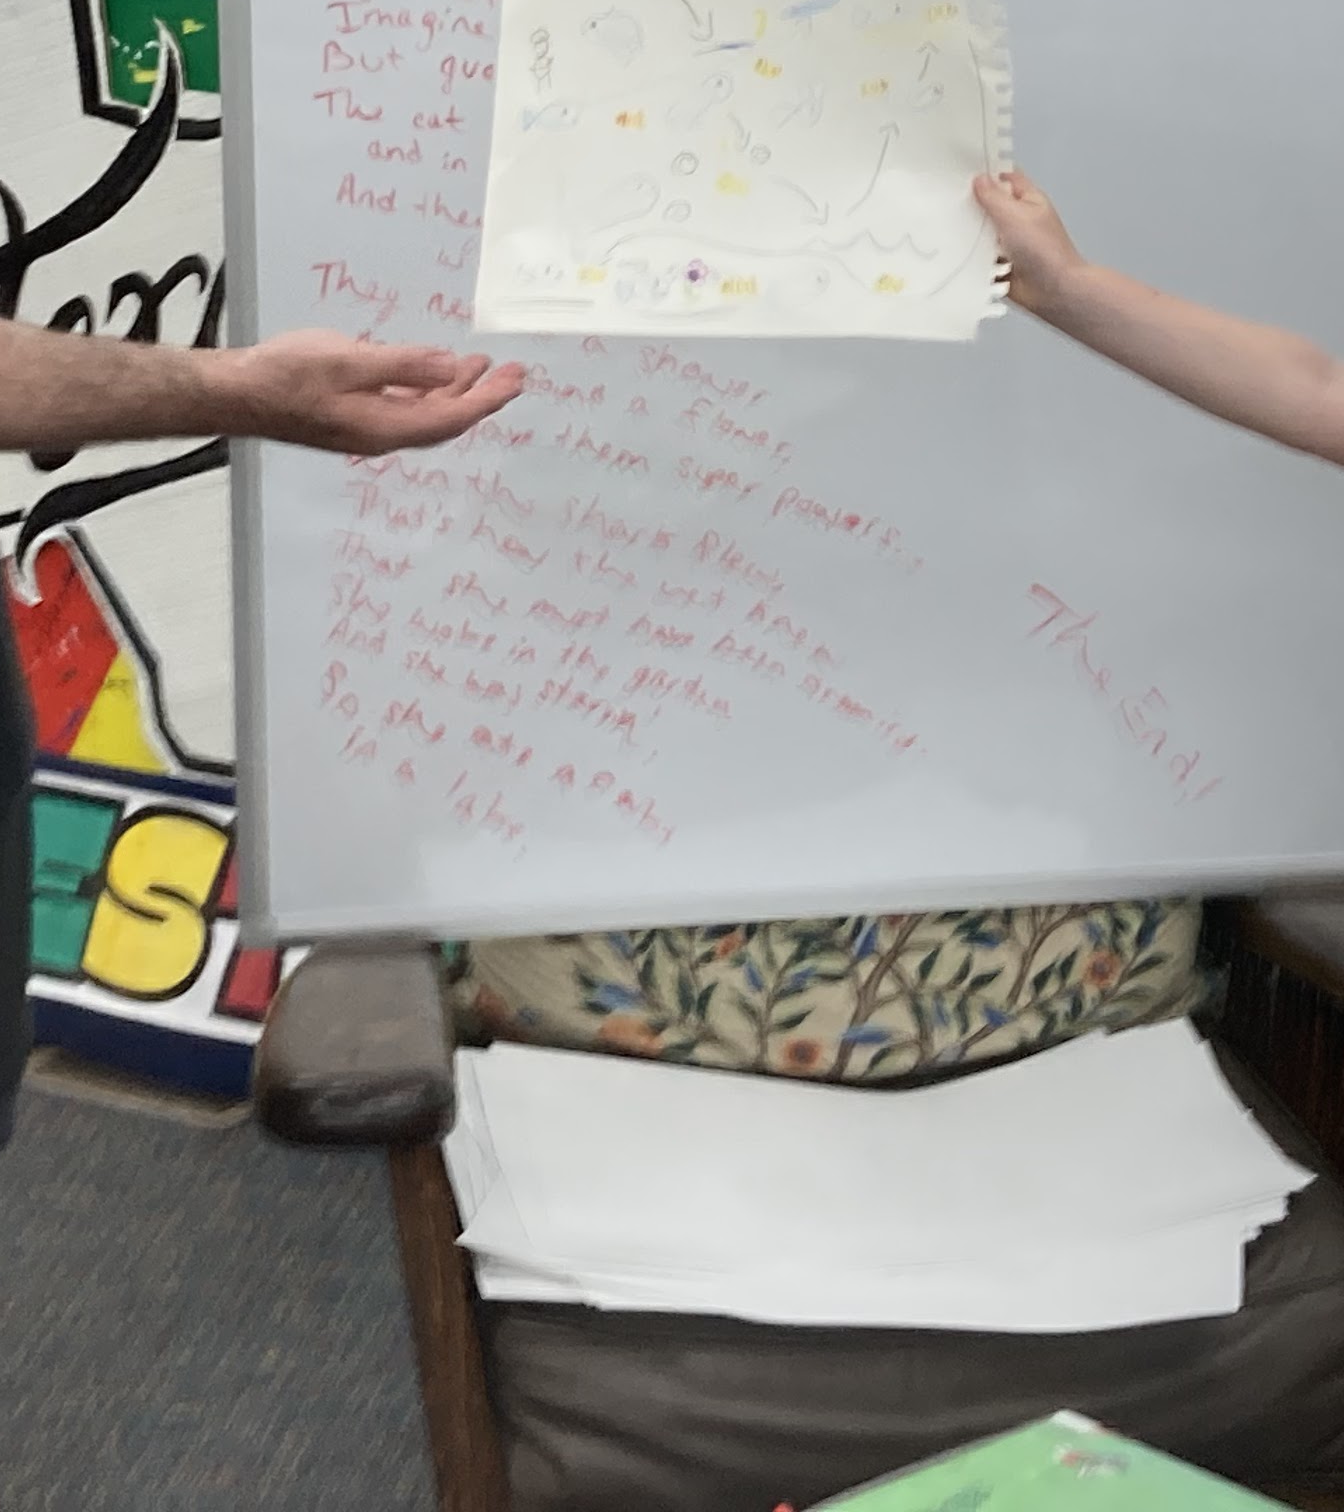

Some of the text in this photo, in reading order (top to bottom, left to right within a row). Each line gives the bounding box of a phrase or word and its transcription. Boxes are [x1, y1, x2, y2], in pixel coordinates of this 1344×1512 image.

[325, 0, 487, 52] Imagine
[321, 39, 404, 74] But
[367, 139, 422, 163] and
[336, 172, 397, 216] And
[312, 258, 400, 323] They
[1025, 583, 1111, 694] The
